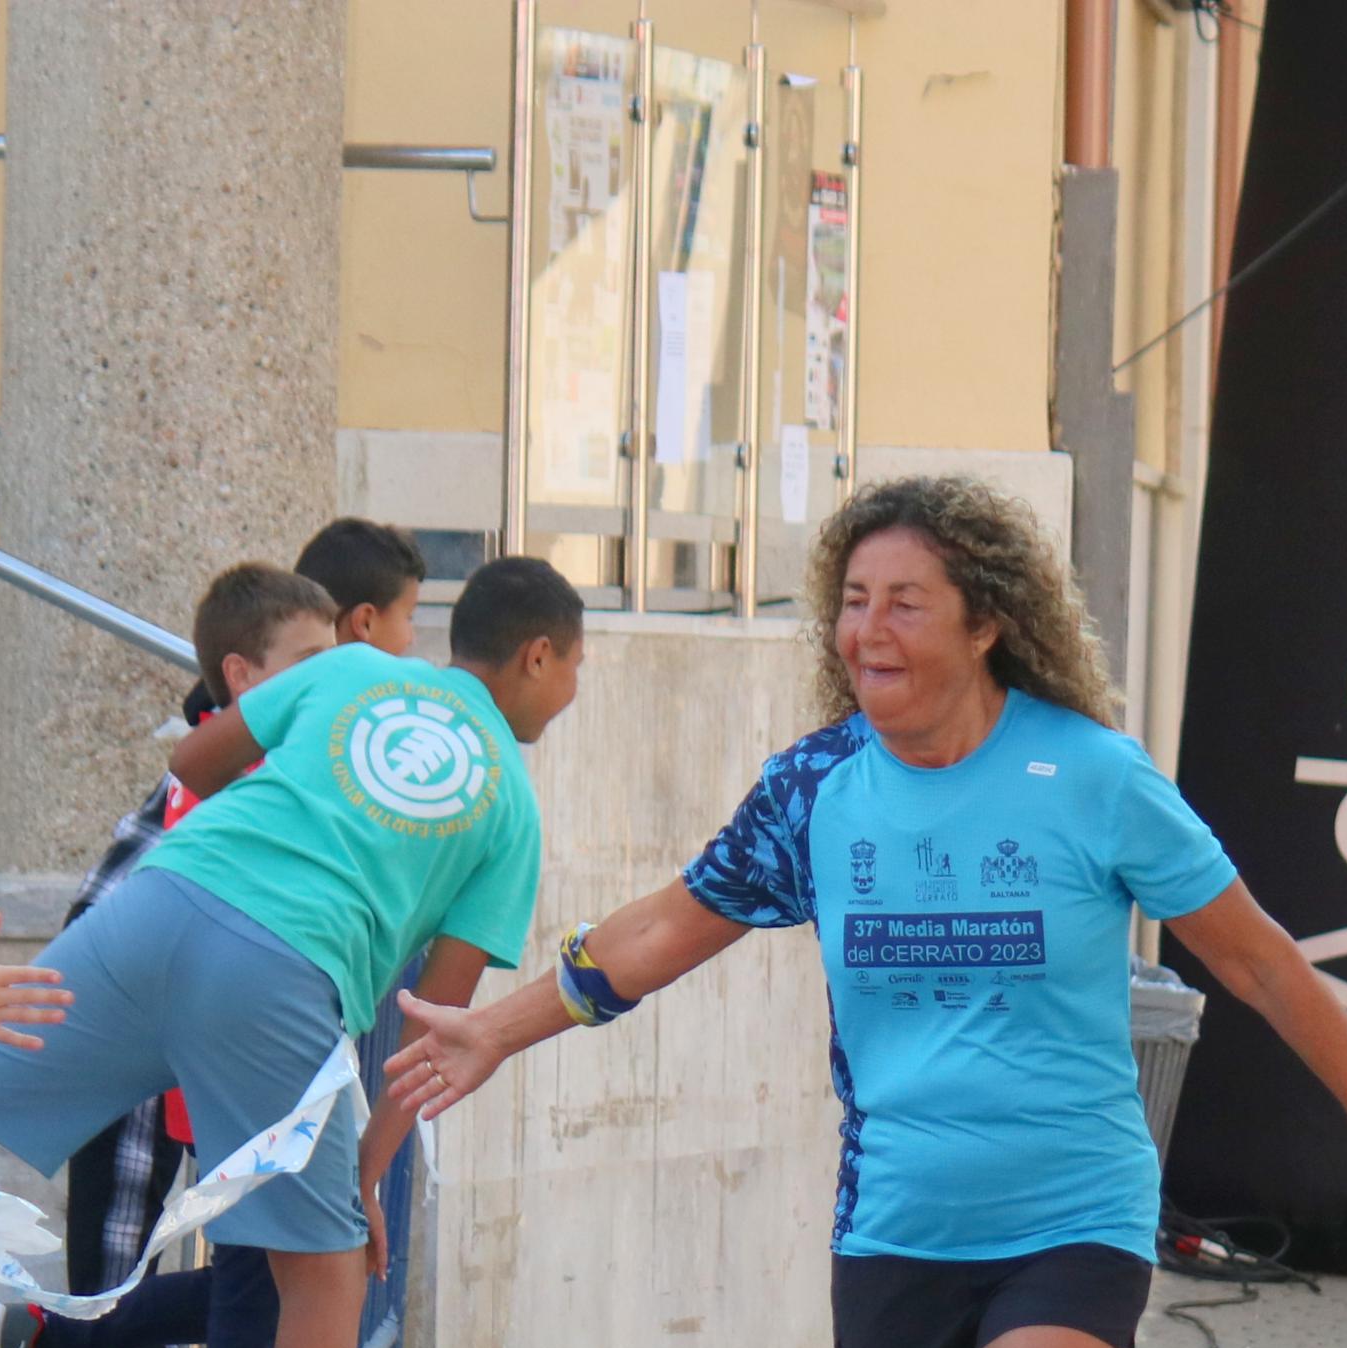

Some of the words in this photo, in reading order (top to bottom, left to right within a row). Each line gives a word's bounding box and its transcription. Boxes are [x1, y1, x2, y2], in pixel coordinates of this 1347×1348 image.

[888, 920, 945, 937] Media
[952, 918, 1034, 936] Maratón
[847, 945, 874, 963] del
[880, 944, 983, 963] CERRATO
[990, 943, 1042, 961] 2023
